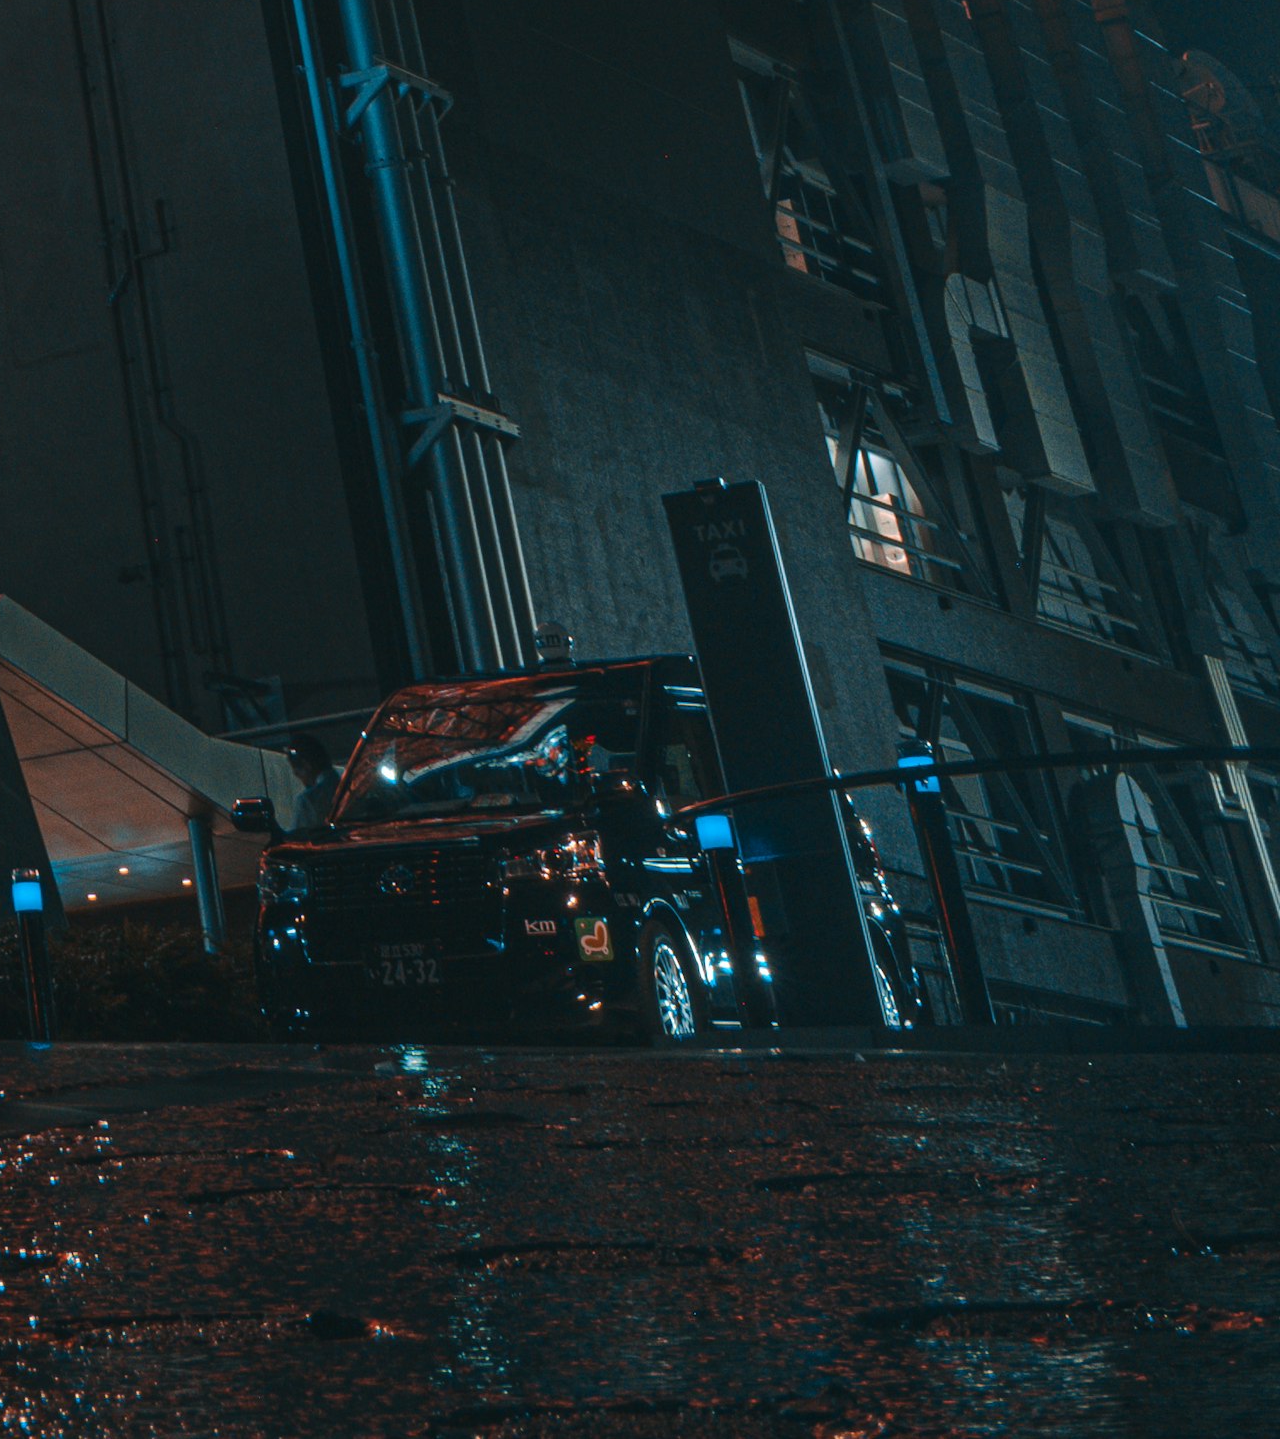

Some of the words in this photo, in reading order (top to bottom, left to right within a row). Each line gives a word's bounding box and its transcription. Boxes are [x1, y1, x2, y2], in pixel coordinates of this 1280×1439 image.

[693, 519, 745, 542] TAXI
[524, 919, 556, 934] km
[381, 958, 440, 986] 24-32
